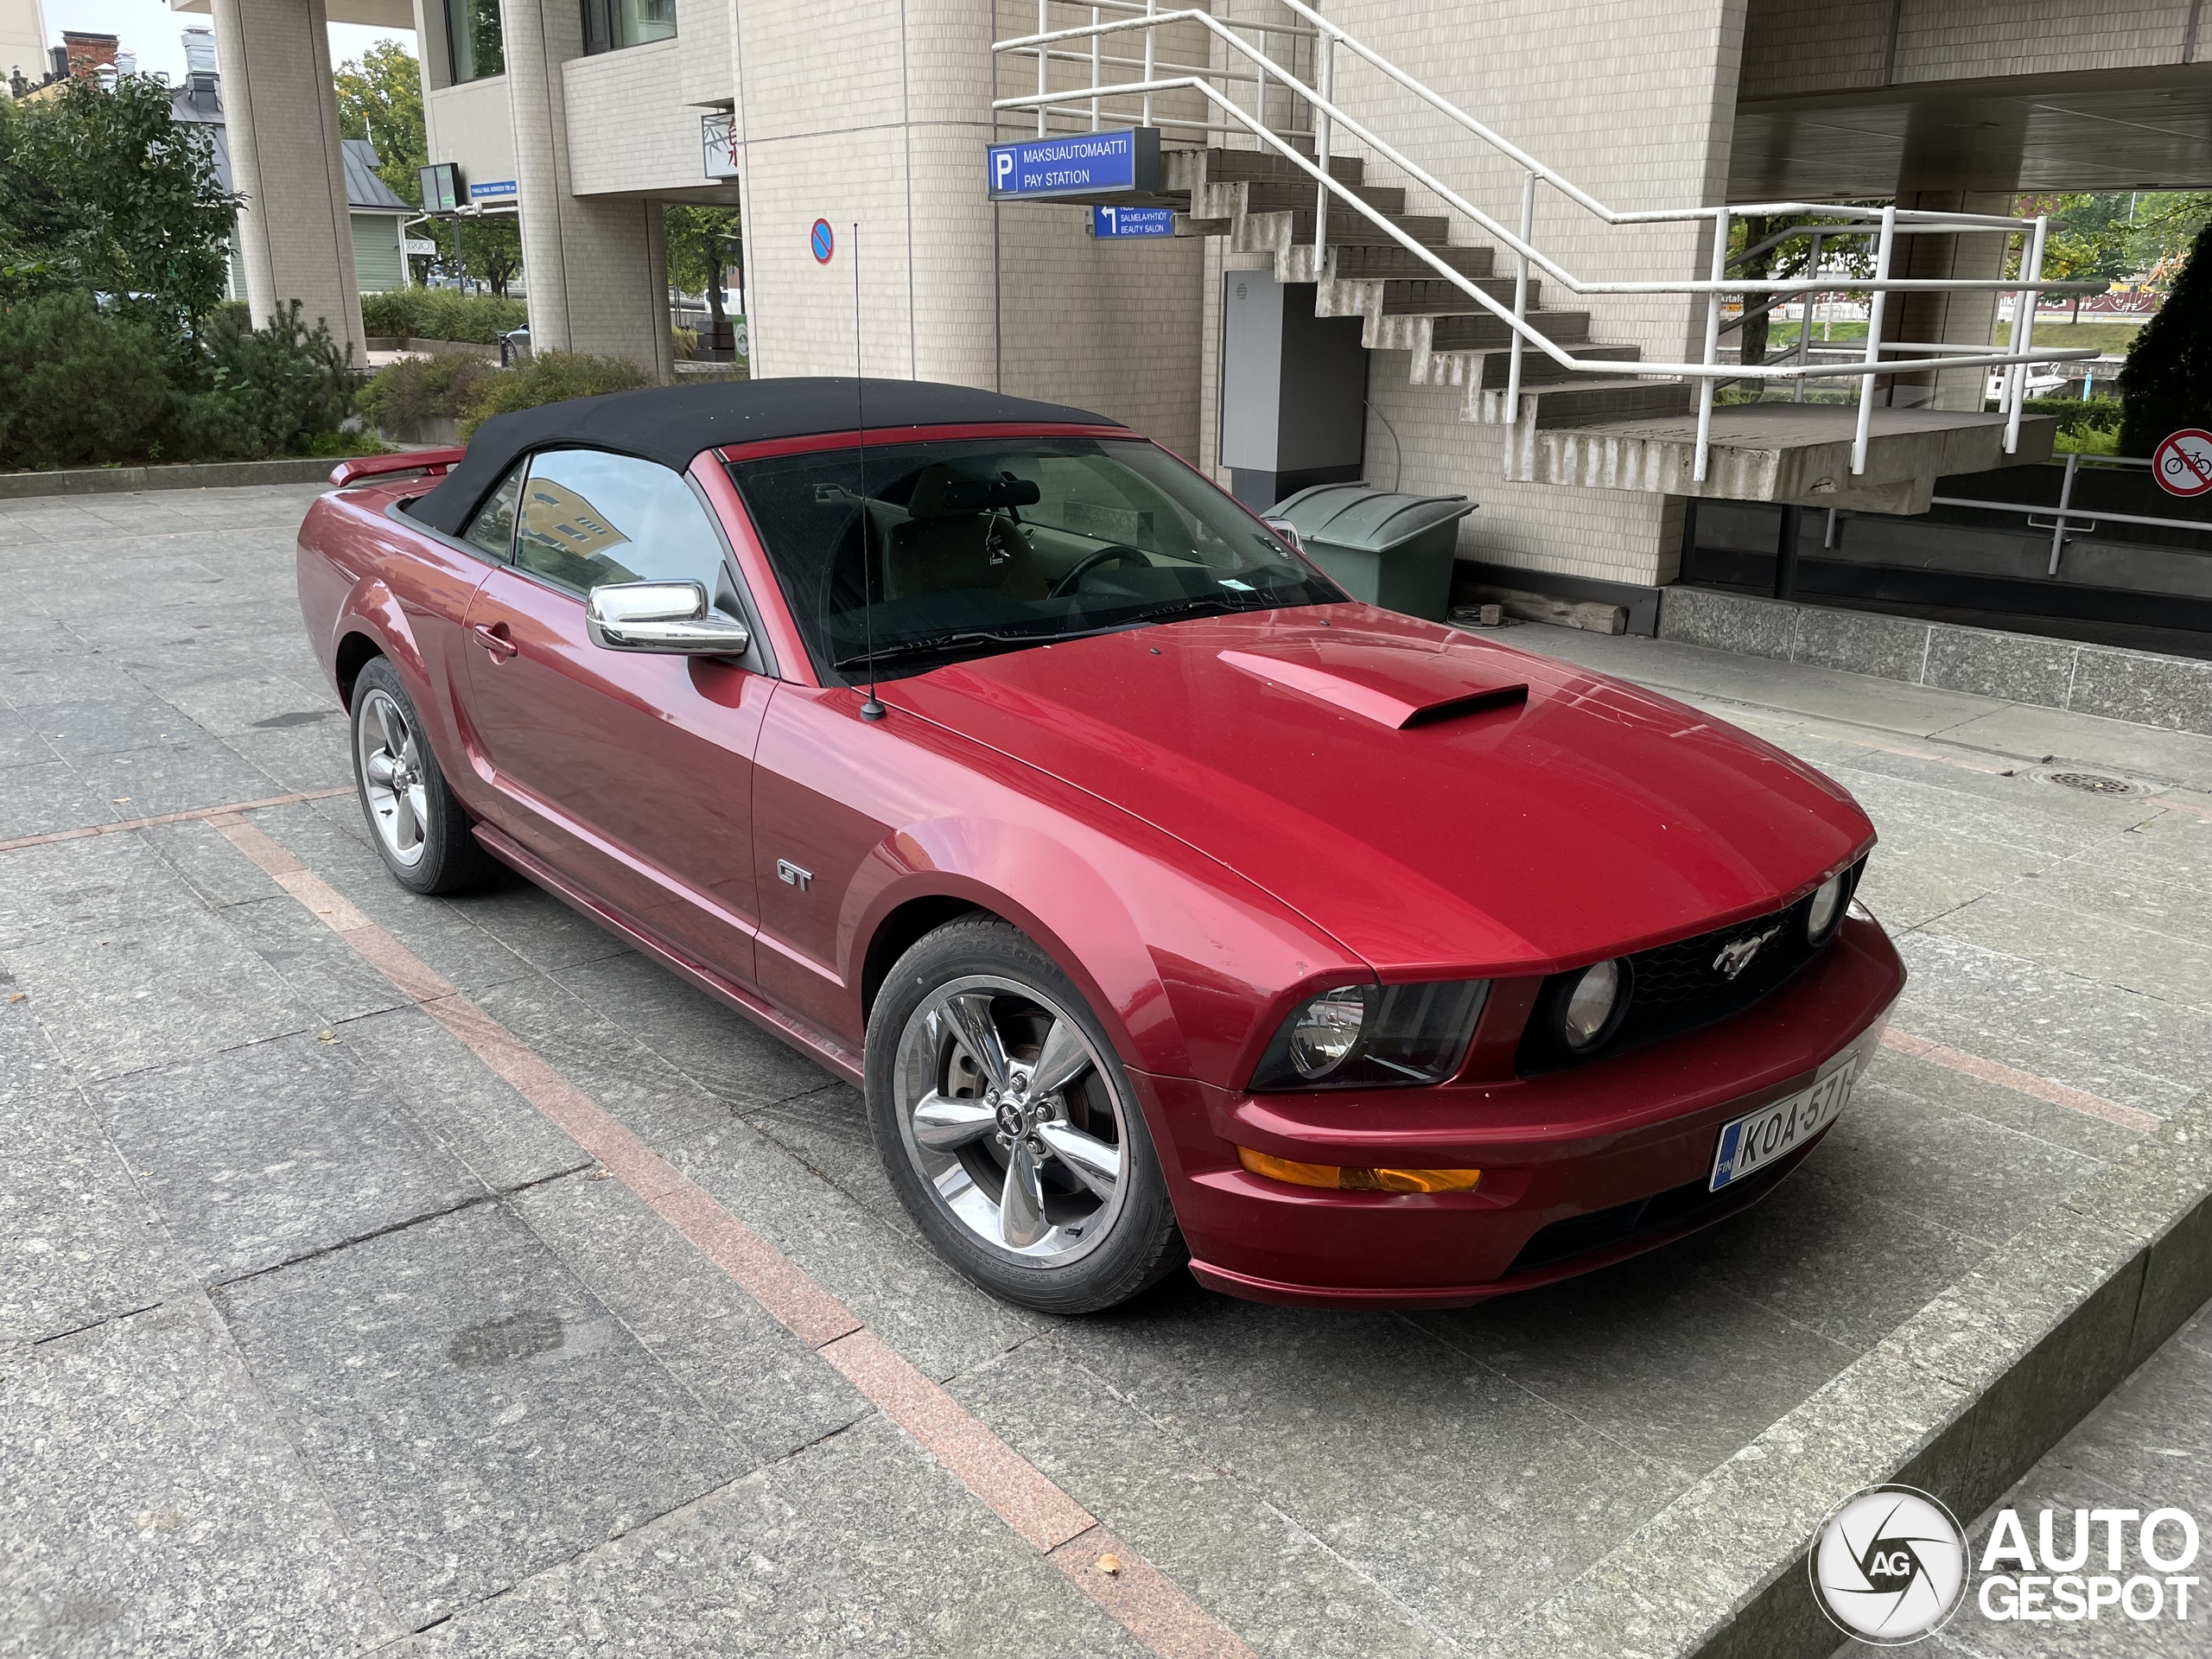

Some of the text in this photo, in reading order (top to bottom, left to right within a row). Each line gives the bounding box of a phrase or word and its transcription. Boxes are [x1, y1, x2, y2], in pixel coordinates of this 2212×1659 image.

[1023, 139, 1127, 164] MAKSUAUTOMAATTI
[1024, 168, 1090, 188] PAY STATION
[1120, 212, 1167, 222] SALMELA-YHTIÖT
[1121, 225, 1164, 234] BEAUTY SALON
[777, 858, 813, 892] GT
[949, 939, 1066, 984] 235/50R18
[1738, 1068, 1848, 1168] KOA-571
[1716, 1159, 1734, 1177] FIN
